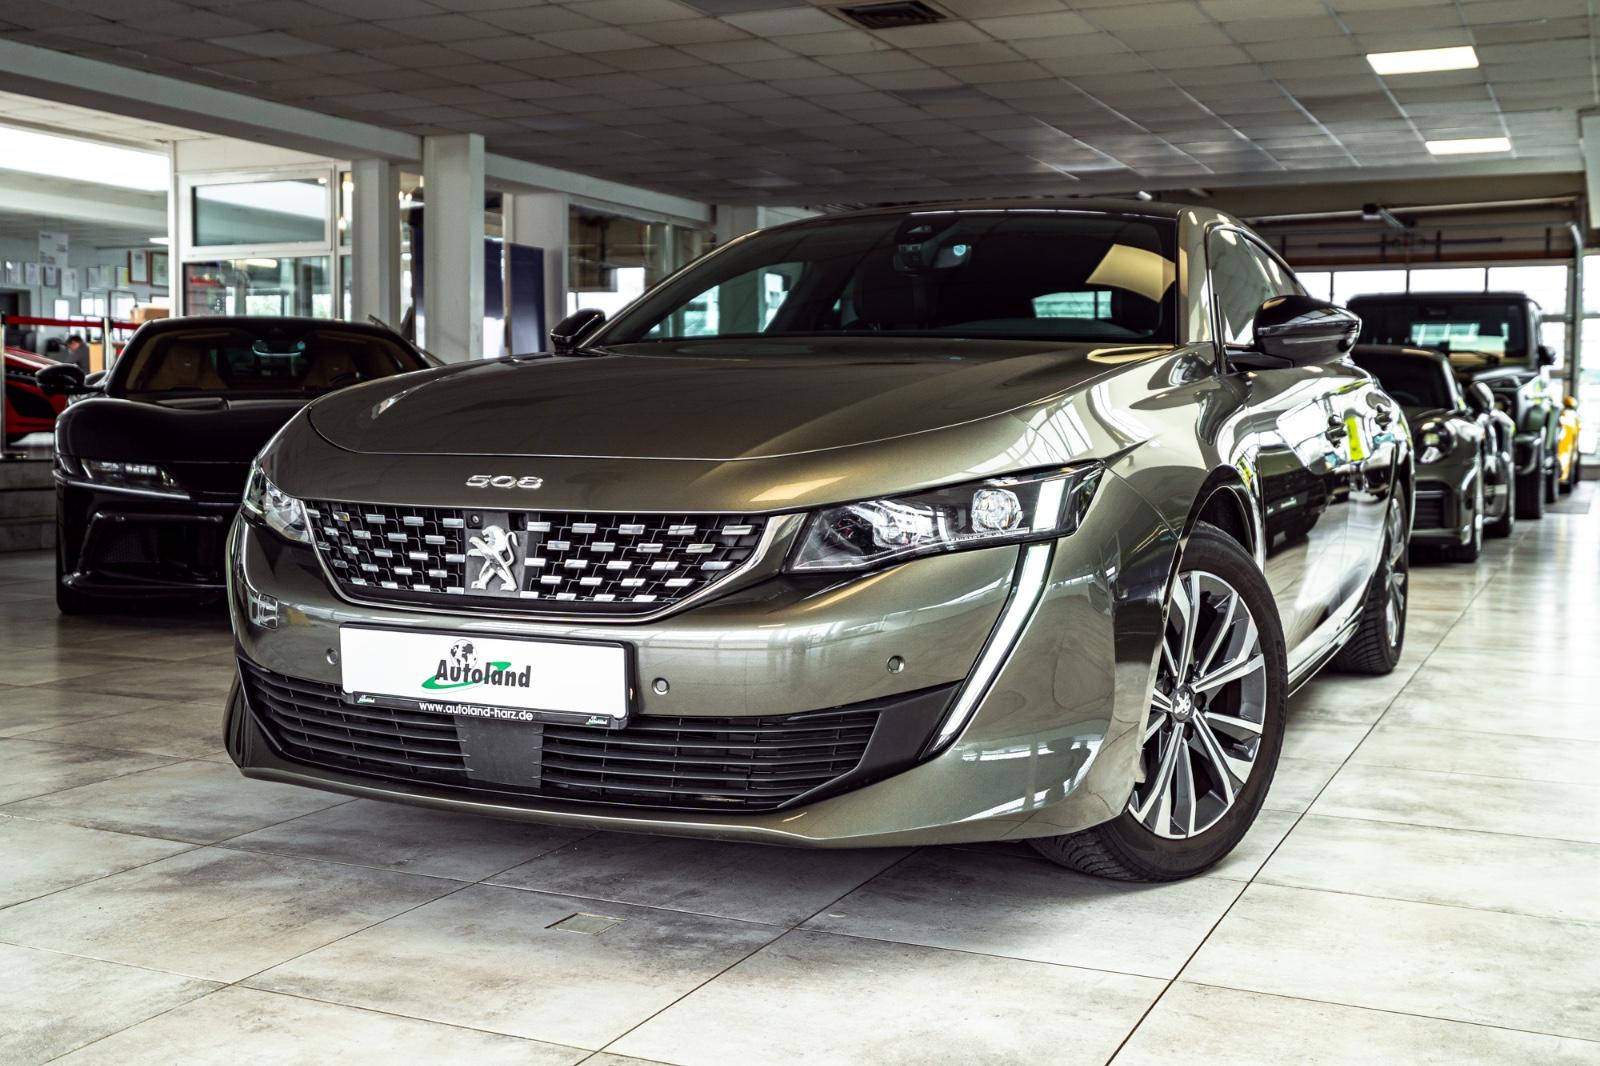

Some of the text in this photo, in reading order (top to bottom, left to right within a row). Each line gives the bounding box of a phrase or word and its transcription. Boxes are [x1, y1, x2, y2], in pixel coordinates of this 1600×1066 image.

[465, 474, 543, 489] 508
[435, 659, 532, 688] Autoland
[418, 702, 534, 721] www.autoland-harz.de
